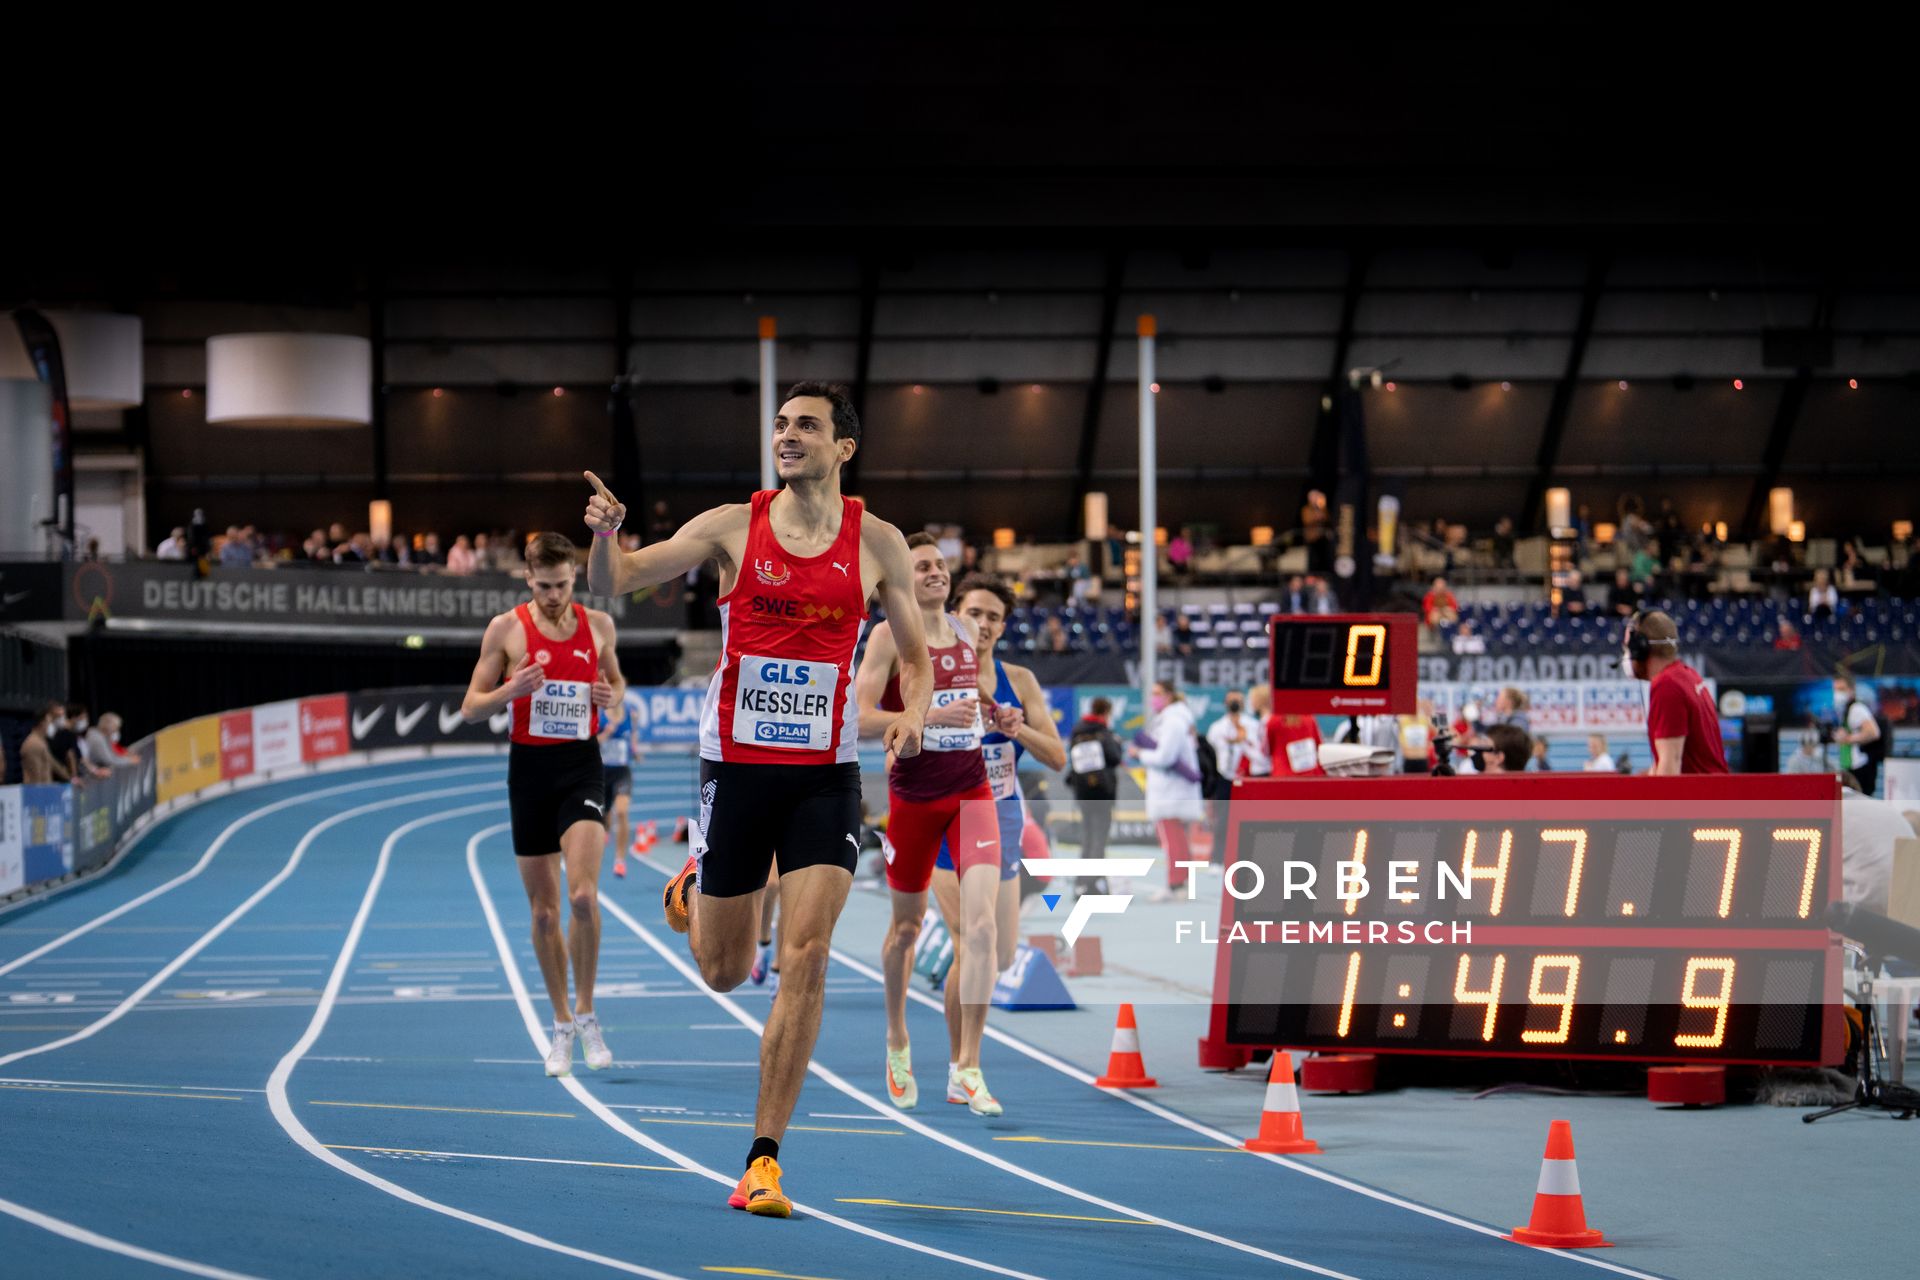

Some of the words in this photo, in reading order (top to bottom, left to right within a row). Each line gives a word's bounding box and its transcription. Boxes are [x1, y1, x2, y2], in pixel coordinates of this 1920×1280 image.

[755, 558, 772, 572] LG
[143, 580, 289, 612] DEUTSCHE
[752, 595, 799, 617] SWE
[1343, 624, 1386, 686] 0
[535, 700, 588, 718] REUTHER
[741, 688, 828, 717] KESSLER
[557, 723, 578, 732] PLAN
[778, 726, 808, 737] PLAN
[984, 747, 1002, 761] LS
[987, 762, 1013, 779] ARZER
